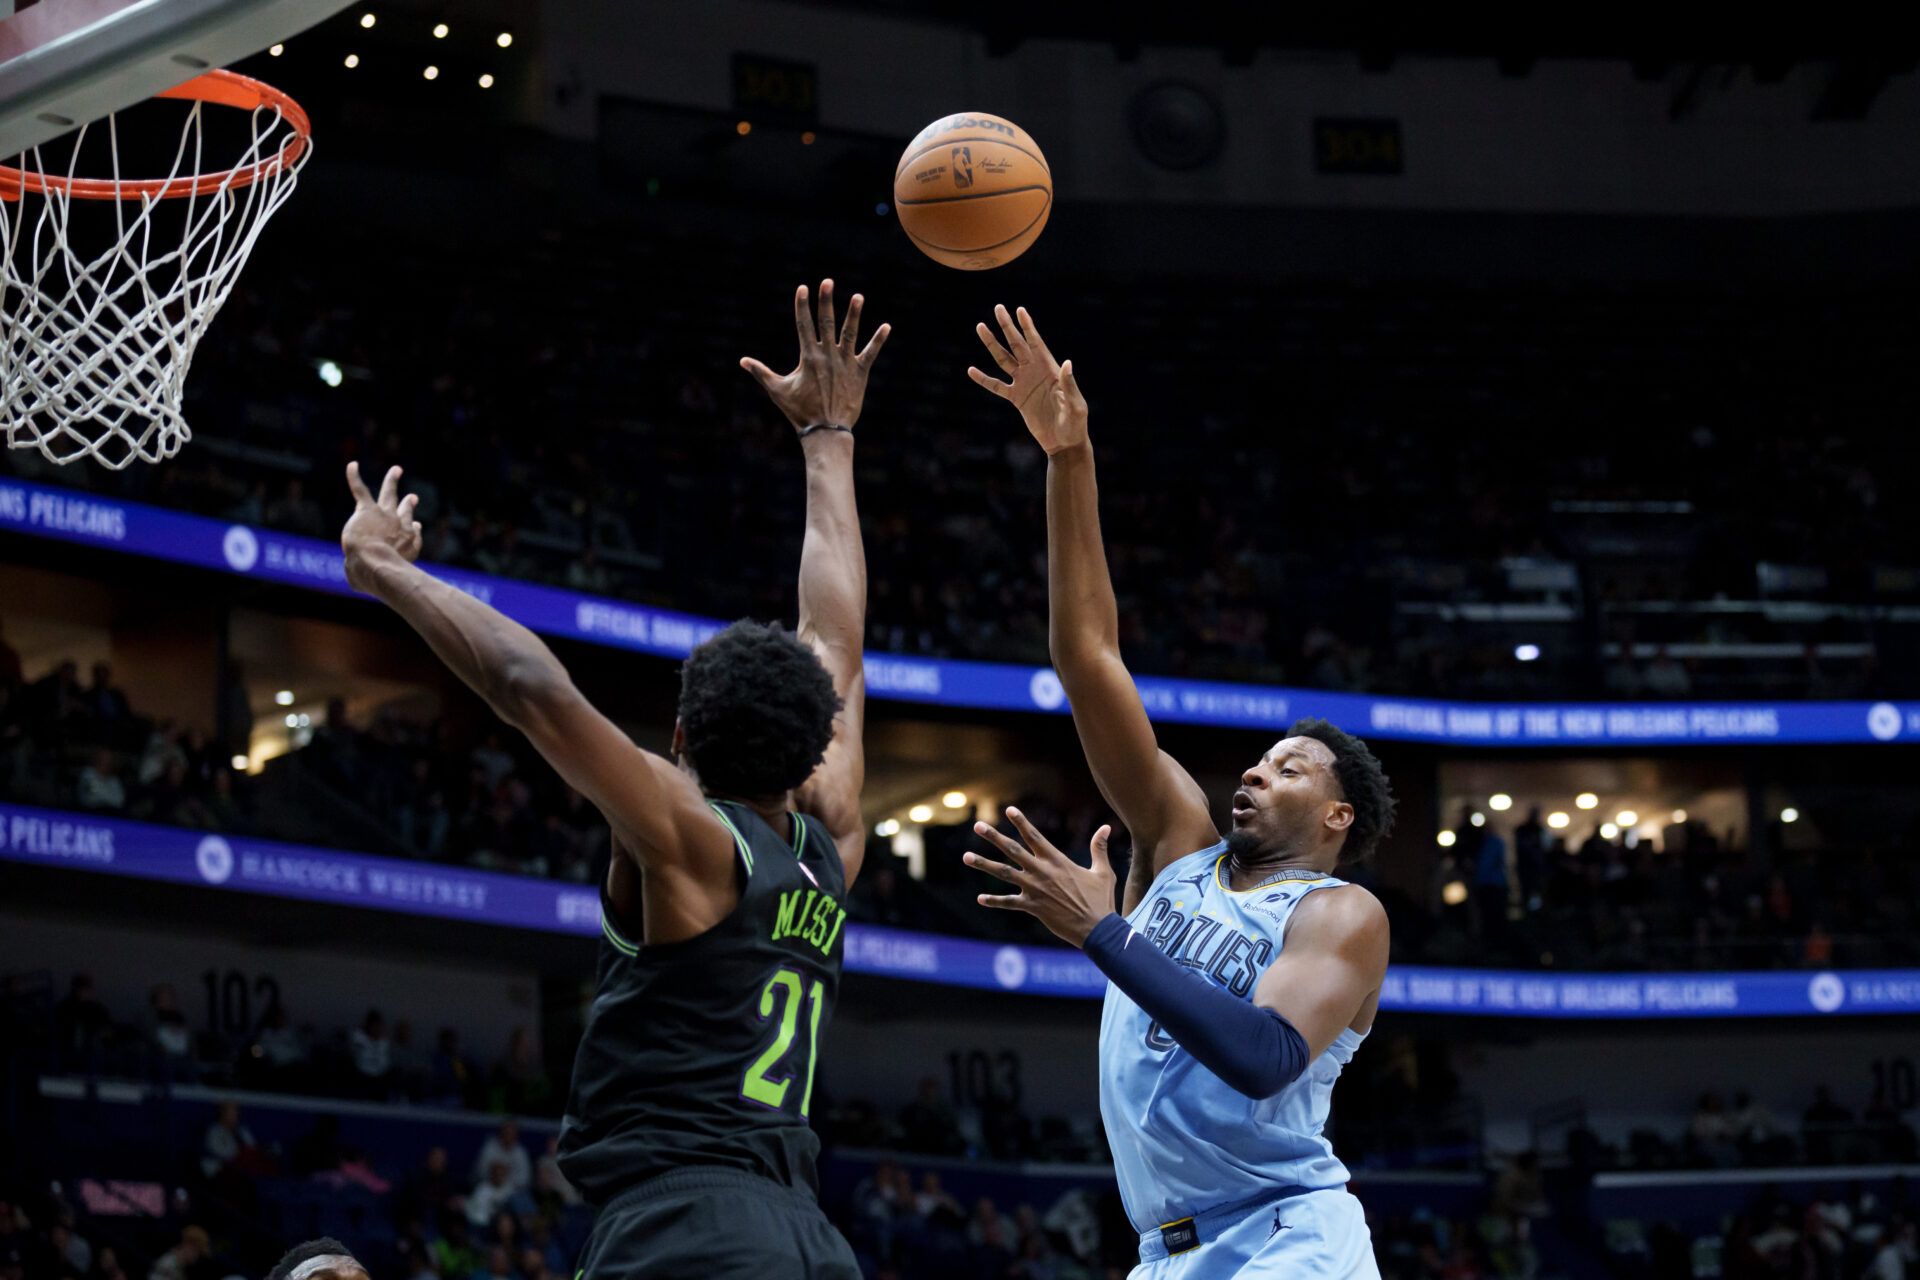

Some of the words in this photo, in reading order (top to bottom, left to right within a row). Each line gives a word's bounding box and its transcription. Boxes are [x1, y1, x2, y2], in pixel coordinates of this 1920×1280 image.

[29, 491, 126, 541] PELICANS
[771, 889, 847, 956] MISSI
[204, 969, 279, 1033] 102
[739, 964, 825, 1121] 21
